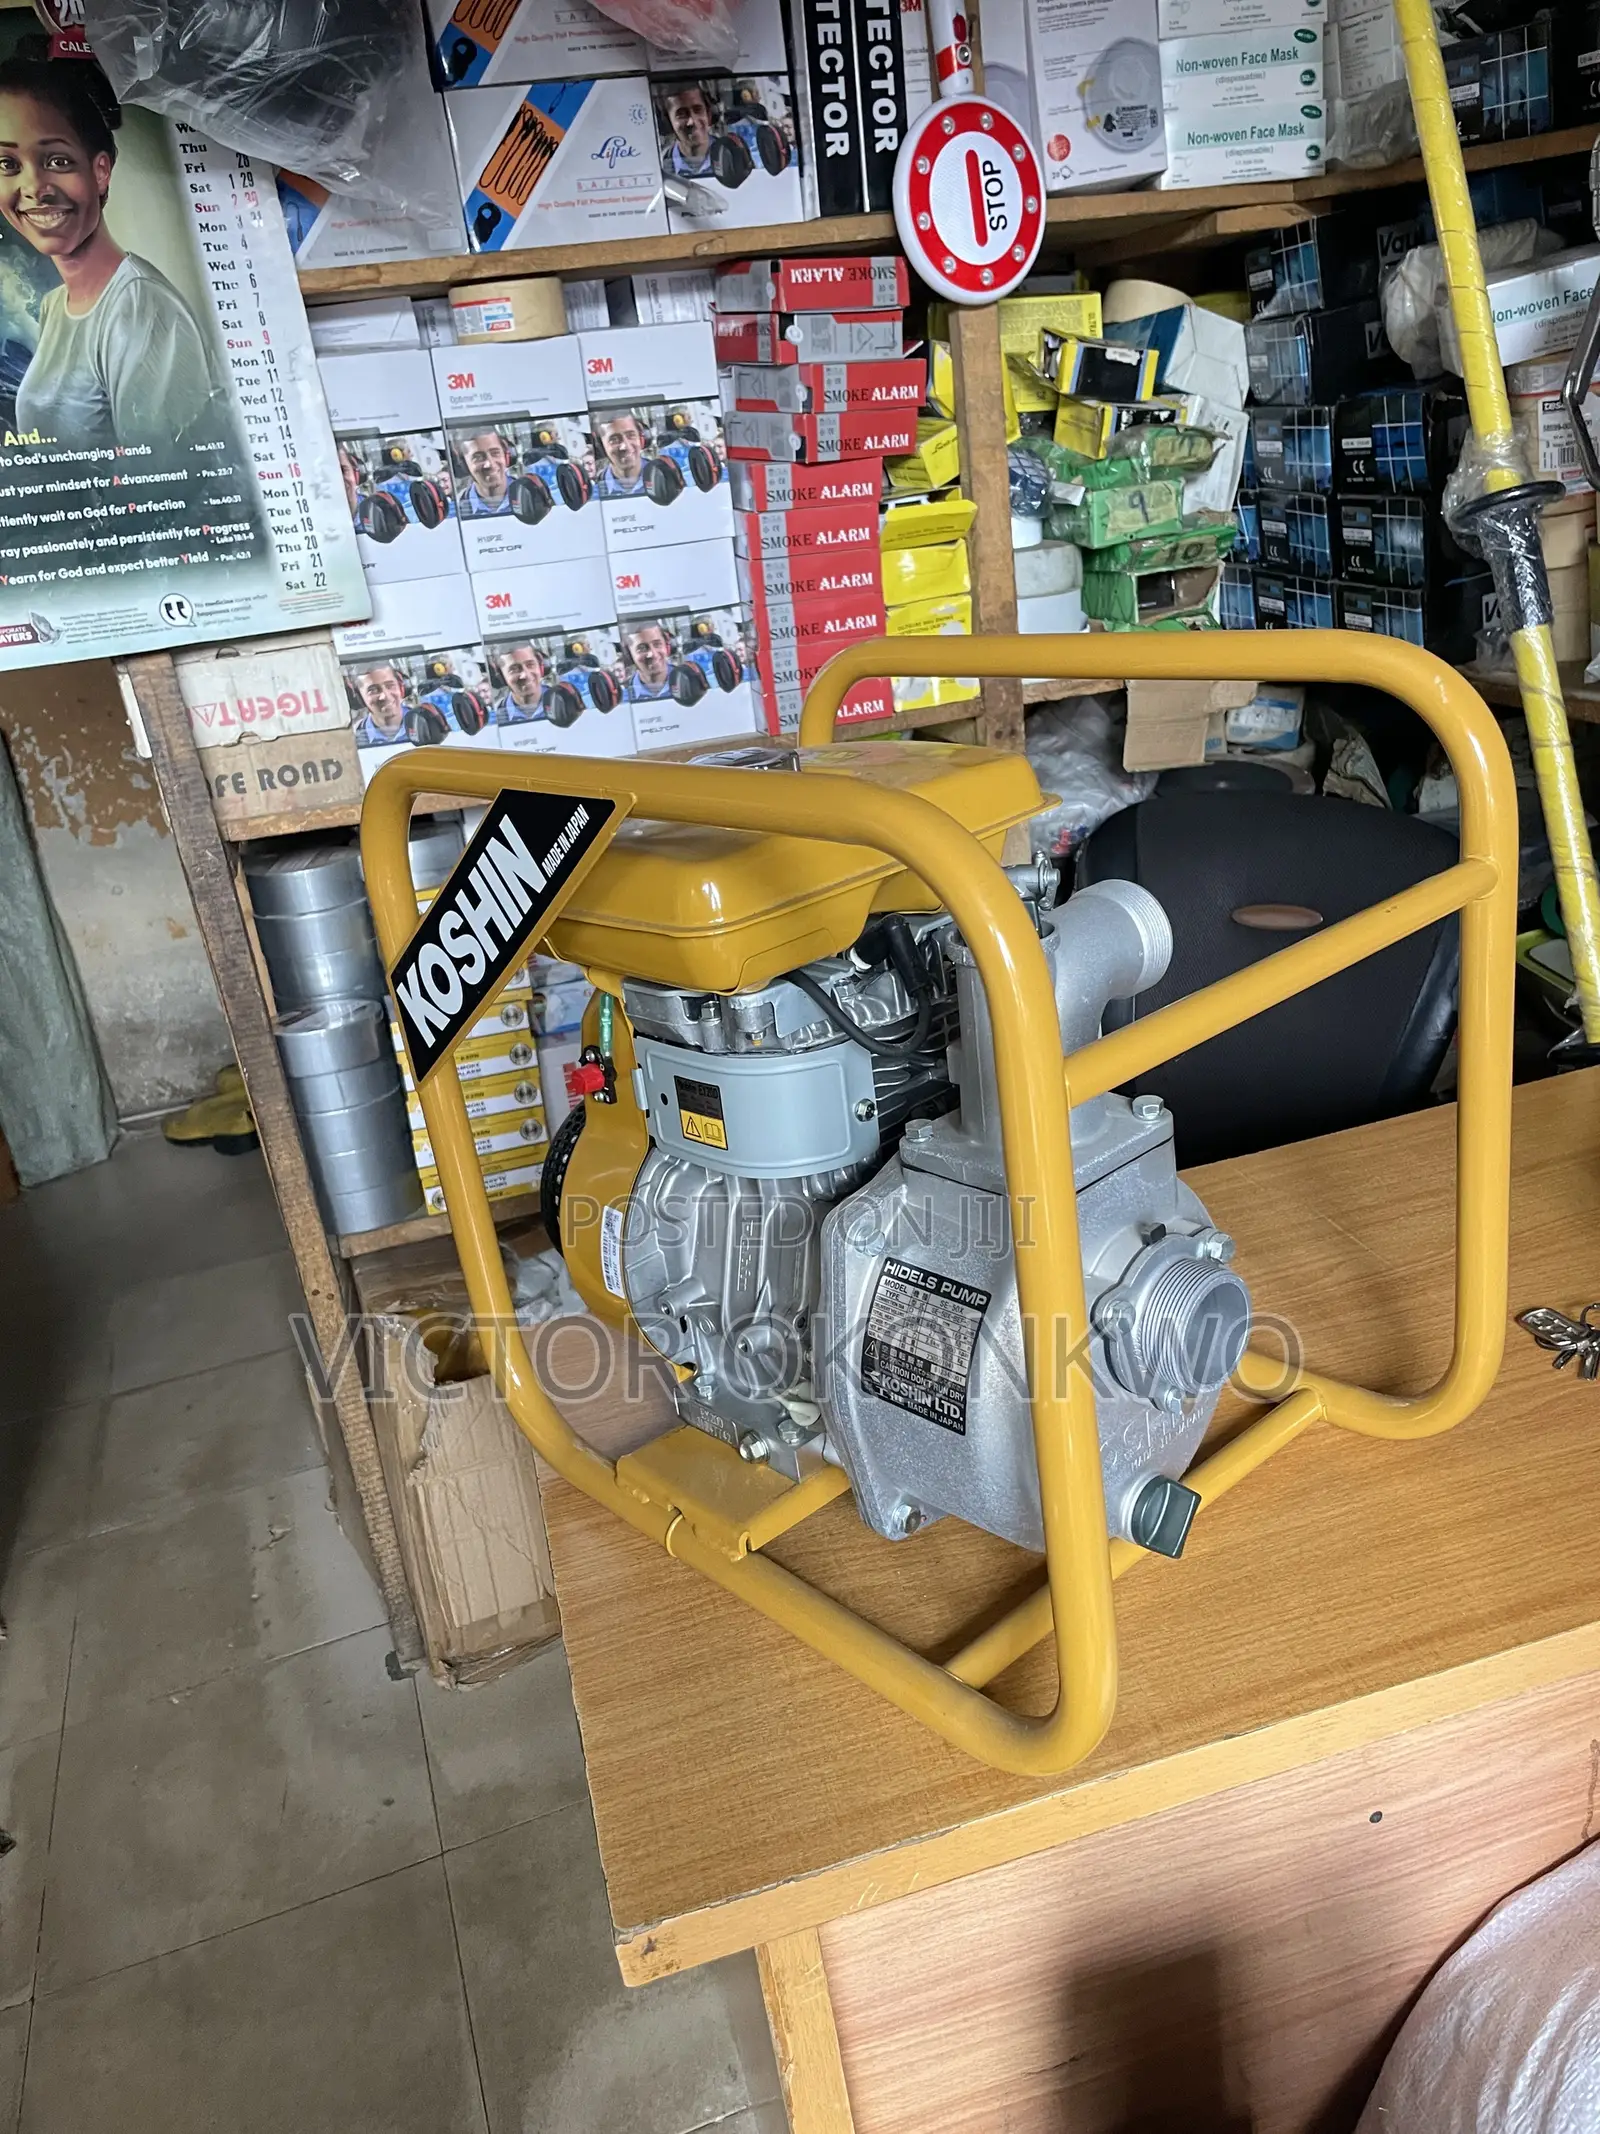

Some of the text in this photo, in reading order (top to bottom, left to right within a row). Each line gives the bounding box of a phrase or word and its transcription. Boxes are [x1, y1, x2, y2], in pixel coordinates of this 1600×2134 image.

[59, 40, 93, 53] CALE
[1176, 47, 1299, 74] Non-woven Face Mask
[175, 123, 200, 134] We
[1187, 122, 1305, 146] Non-woven Face Mask
[180, 143, 207, 153] Thu
[184, 152, 250, 173] Fri 28
[190, 172, 254, 193] Sat 1 29
[982, 160, 1008, 231] STOP
[195, 203, 220, 213] Sun
[199, 223, 227, 233] Mon
[203, 242, 228, 252] Tue
[208, 261, 236, 271] Wed
[791, 266, 896, 283] SMOKE ALARM
[250, 274, 257, 288] 6
[217, 292, 260, 310] Fri 7
[222, 311, 266, 330] Sat 8
[226, 330, 271, 349] Sun 9
[231, 349, 275, 369] Mon 10
[587, 358, 613, 374] 3M
[235, 368, 279, 387] Tue 11
[447, 373, 475, 390] 3M
[240, 387, 284, 406] Wed 12
[824, 385, 919, 404] SMOKE ALARM
[244, 406, 288, 425] Thu 13
[248, 424, 292, 444] Fri 14
[817, 433, 909, 453] SMOKE ALARM
[0, 444, 152, 467] to God's unchanging Hands
[253, 443, 297, 463] Sat 15
[258, 463, 301, 481] Sun 16
[17, 484, 44, 498] your
[46, 478, 92, 492] mindset
[93, 477, 110, 488] for
[113, 469, 188, 486] Advancement
[263, 481, 304, 499] Mon 17
[766, 483, 873, 503] SMOKE ALARM
[0, 499, 185, 527] tiently wait on God for Perfection
[267, 499, 309, 518] Tue 18
[272, 517, 314, 535] Wed 19
[613, 525, 655, 534] PELTOR
[0, 522, 250, 559] ray passionately and persistently for Progress
[276, 535, 318, 553] Thu 20
[761, 533, 812, 550] SMOKE
[816, 527, 870, 545] ALARM
[479, 544, 522, 555] PELTOR
[0, 551, 209, 586] Yearn for God and expect better Yield
[281, 552, 322, 572] Fri 21
[285, 573, 327, 590] Sat 22
[616, 575, 641, 589] 3M
[765, 572, 873, 596] SMOKE ALARM
[485, 593, 512, 609] 3M
[769, 623, 820, 640] SMOKE
[824, 614, 877, 634] ALARM
[256, 758, 343, 791] ROAD
[541, 804, 590, 878] MADE IN JAPAN
[396, 814, 548, 1048] KOSHIN
[884, 1261, 988, 1306] HIDELS PUMP
[884, 1278, 908, 1294] MODEL
[885, 1289, 900, 1300] TYPE
[880, 1360, 911, 1380] CAUTION
[933, 1383, 949, 1395] RUN
[950, 1389, 965, 1400] DRY
[882, 1374, 932, 1407] KOSHIN
[935, 1394, 964, 1421] LTD.
[907, 1401, 964, 1432] MADE IN JAPAN
